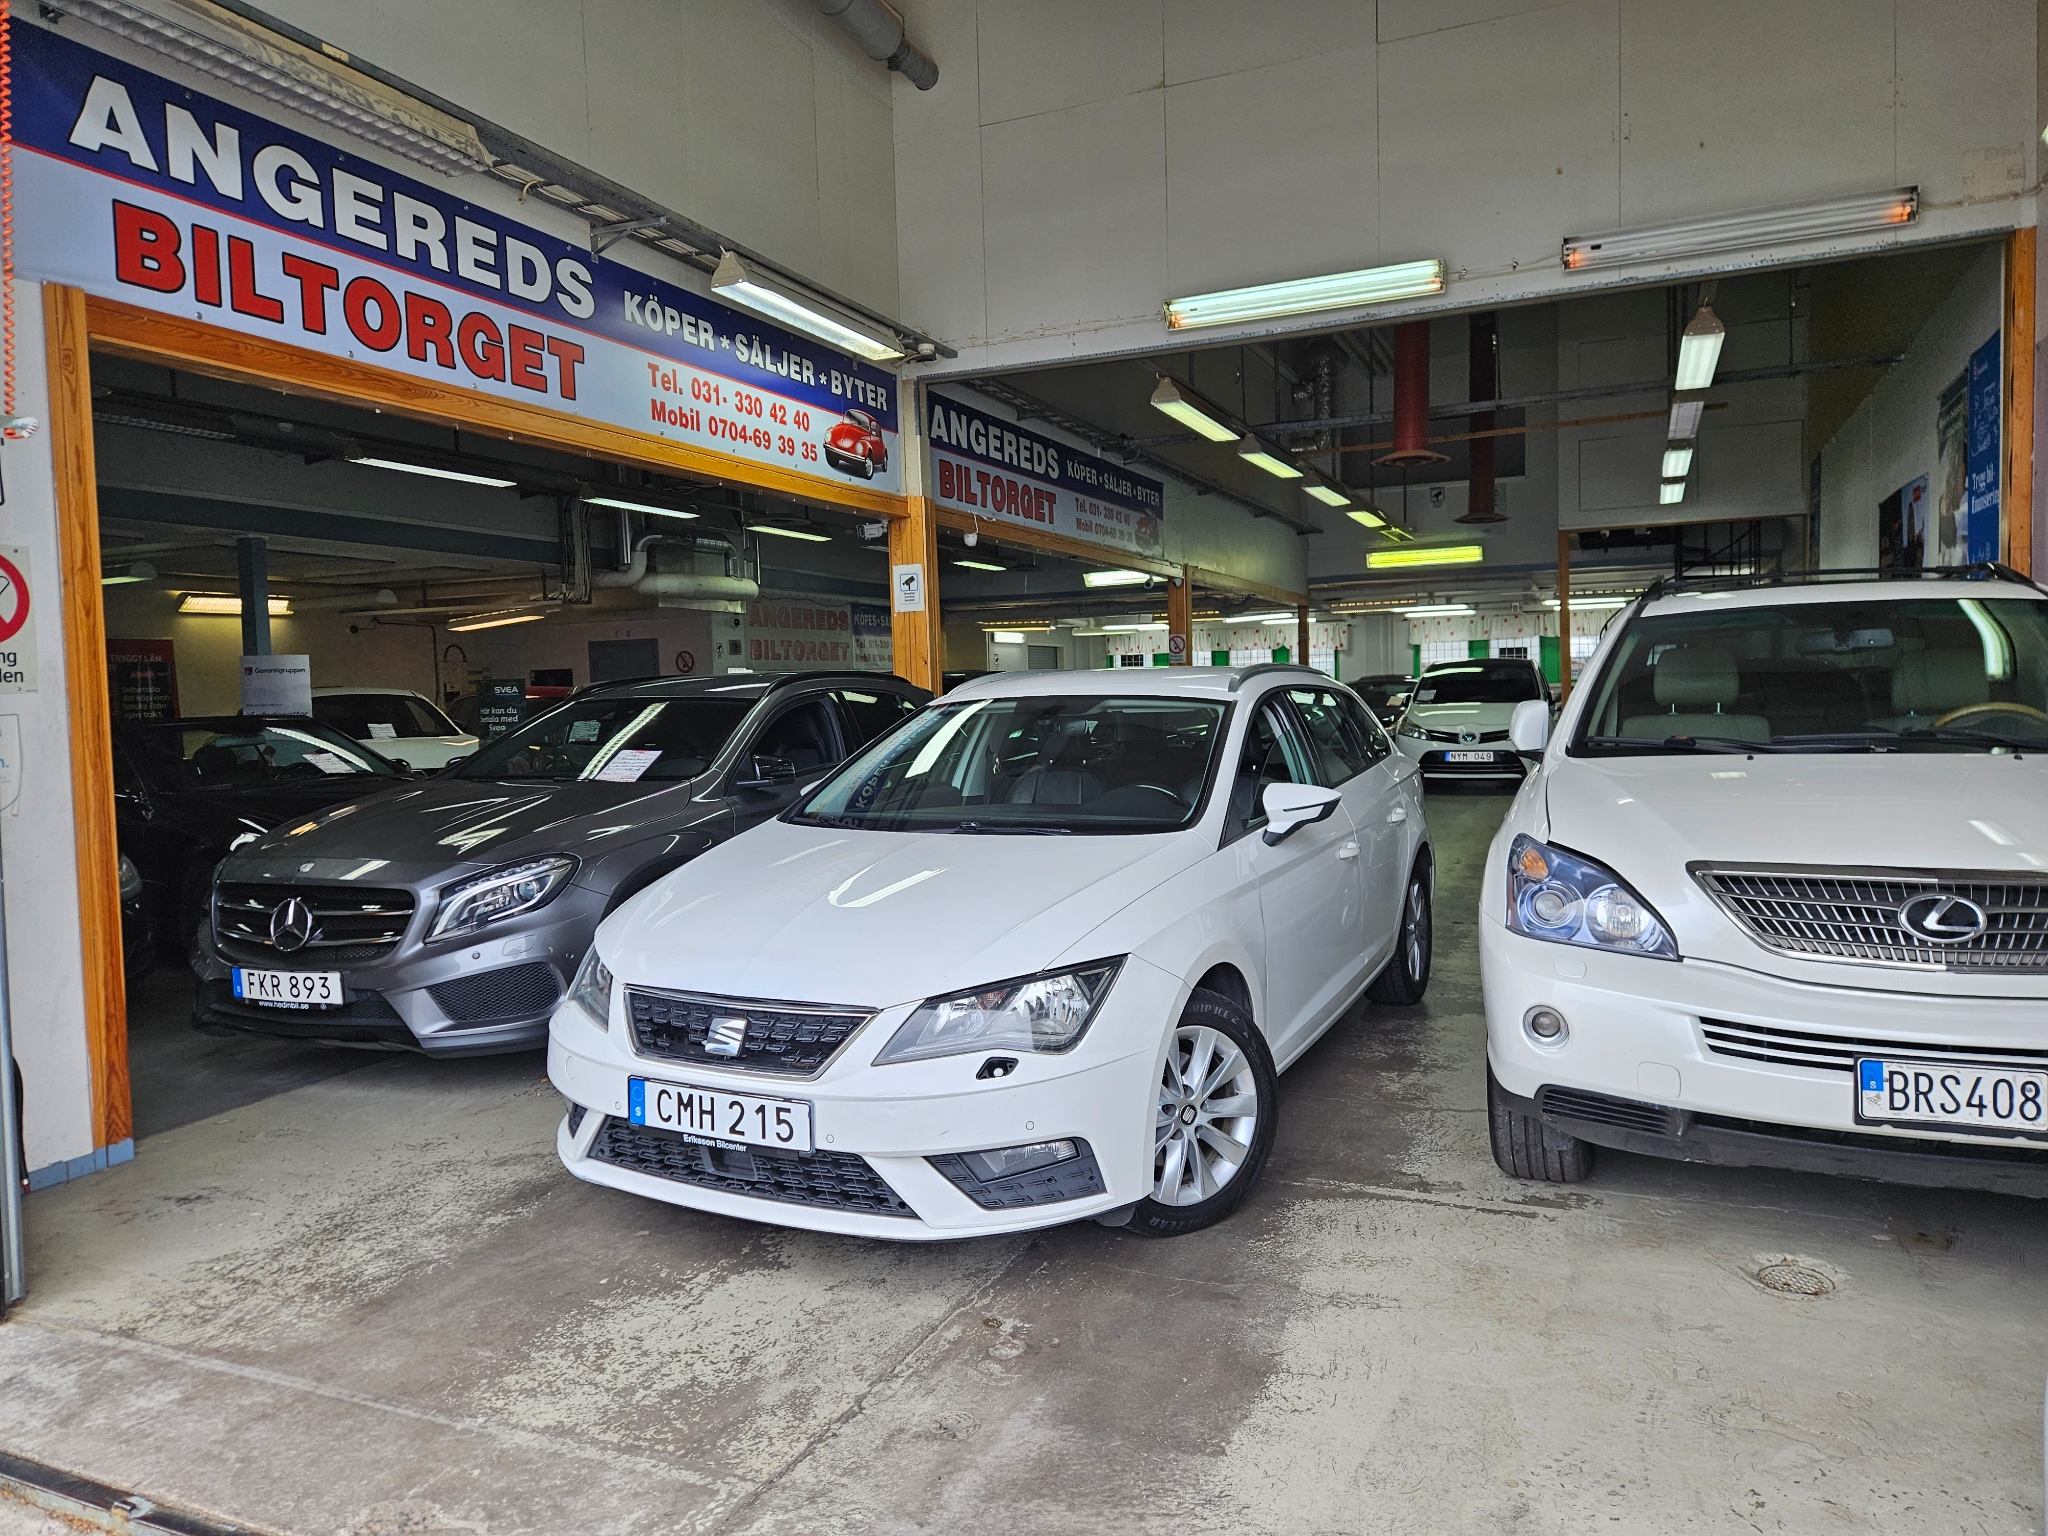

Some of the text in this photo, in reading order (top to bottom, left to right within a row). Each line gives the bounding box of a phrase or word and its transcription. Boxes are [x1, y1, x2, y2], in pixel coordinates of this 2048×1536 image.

[69, 74, 595, 320] ANGEREDS
[112, 198, 585, 401] BILTORGET
[624, 290, 888, 412] KÖPER SÄLJER BYTER
[648, 362, 810, 432] Tel. 031- 330 42 40
[650, 398, 818, 462] Mobil 0704-69 39 35
[931, 404, 1060, 480] ANGEREDS
[939, 459, 1056, 524] BILTORGET
[1067, 460, 1160, 506] KÖPER SÄLJER BYTER
[1075, 498, 1087, 513] Tel.
[1076, 518, 1093, 533] Mobil
[750, 604, 849, 631] ANGEREDS
[750, 640, 850, 662] BILTORGET
[248, 972, 330, 999] FKR 893
[657, 1089, 794, 1143] CMH 215
[1888, 1070, 2042, 1122] BRS408
[683, 1134, 747, 1152] Eriksson Bilcenter
